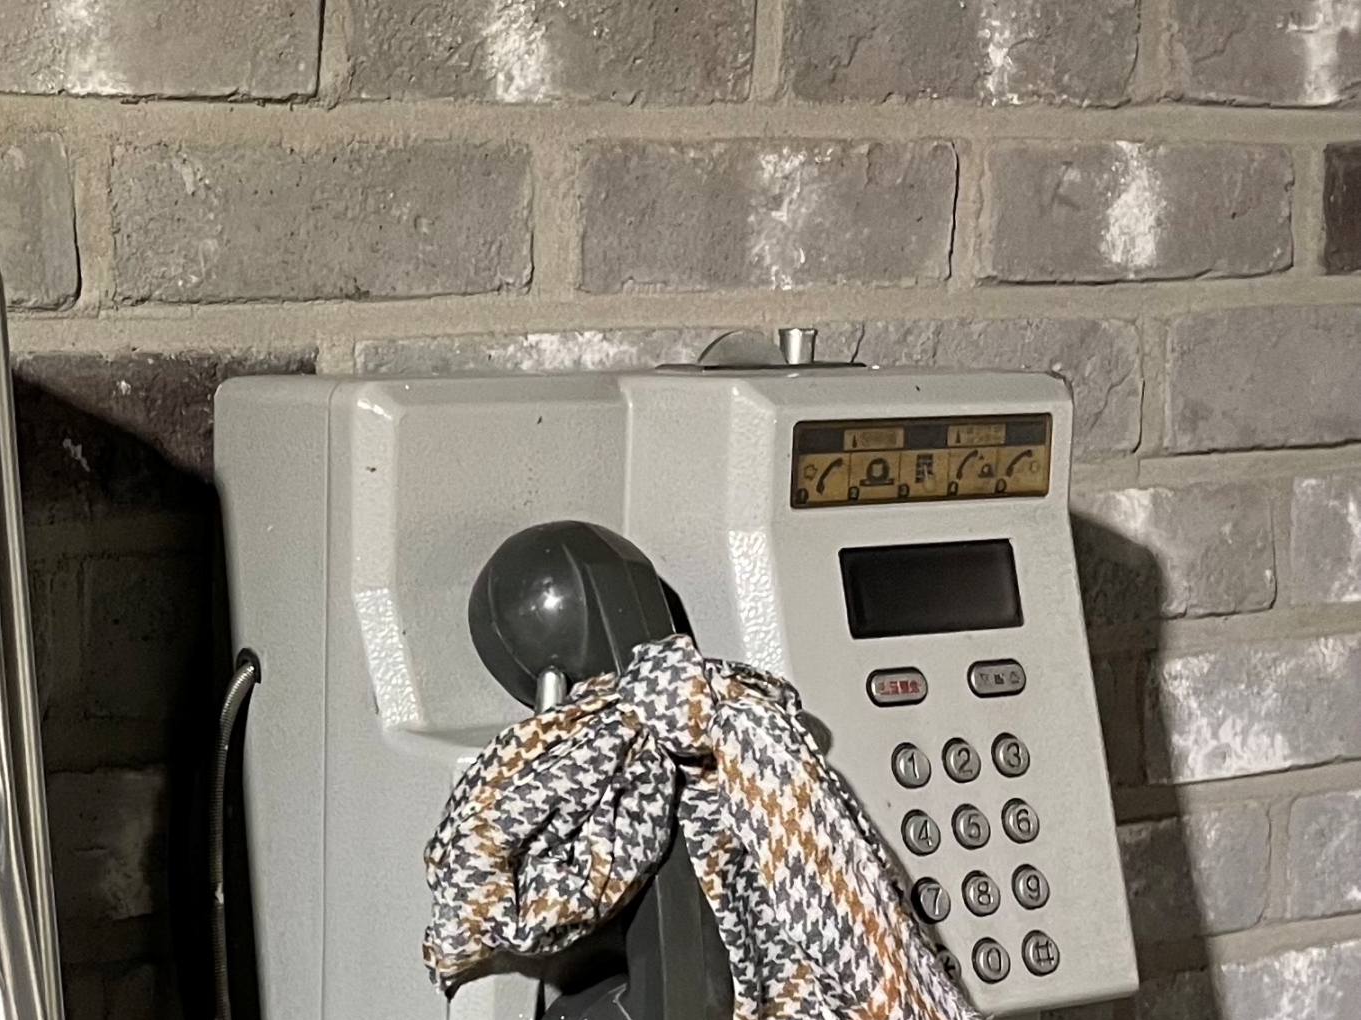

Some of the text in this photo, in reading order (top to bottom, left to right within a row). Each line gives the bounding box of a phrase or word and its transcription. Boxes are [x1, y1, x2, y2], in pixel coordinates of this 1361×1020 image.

[907, 742, 1022, 779] 1 2 3
[918, 808, 1032, 847] 4 5 6
[927, 874, 1041, 916] 7 8 9
[987, 946, 1002, 975] 0
